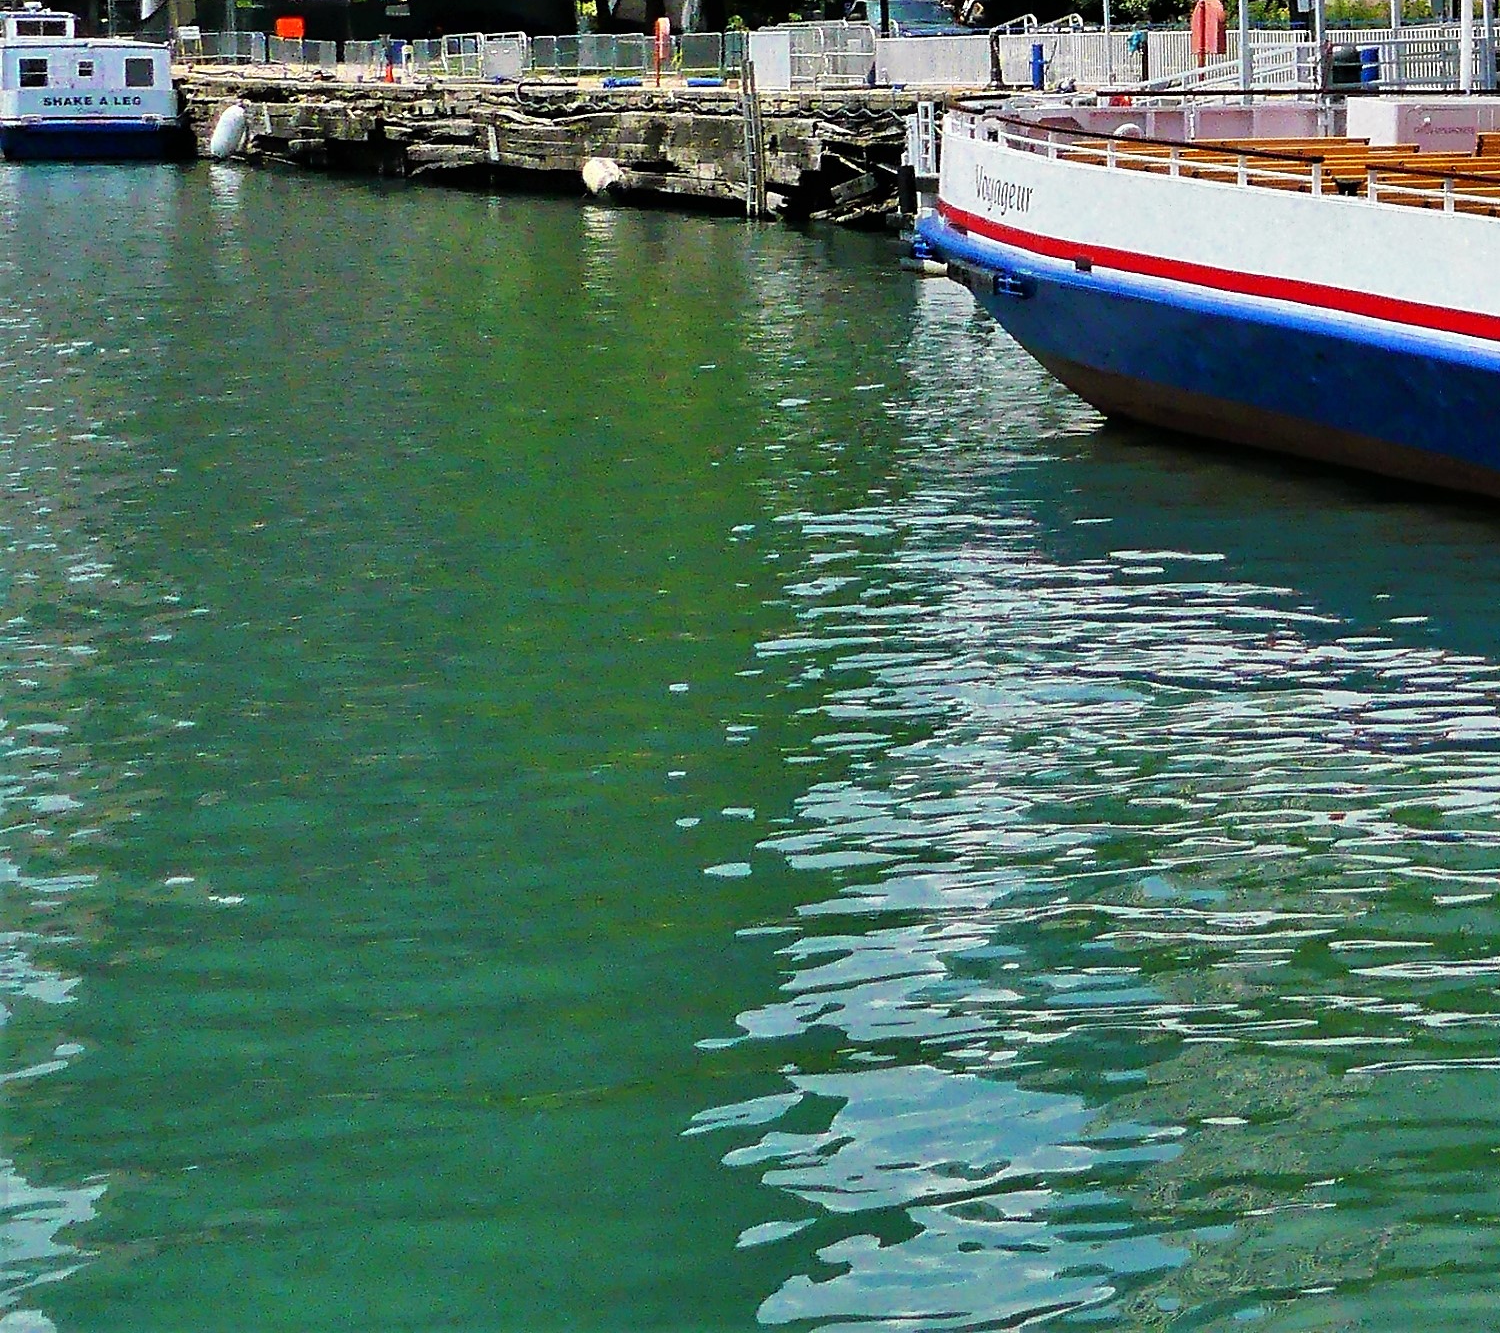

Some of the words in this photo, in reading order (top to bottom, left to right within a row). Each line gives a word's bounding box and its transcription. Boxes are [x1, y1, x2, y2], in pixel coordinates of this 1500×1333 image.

[43, 96, 93, 106] SHAKE
[99, 96, 108, 106] A
[114, 96, 141, 106] LEG
[975, 164, 1034, 216] Voyageur
